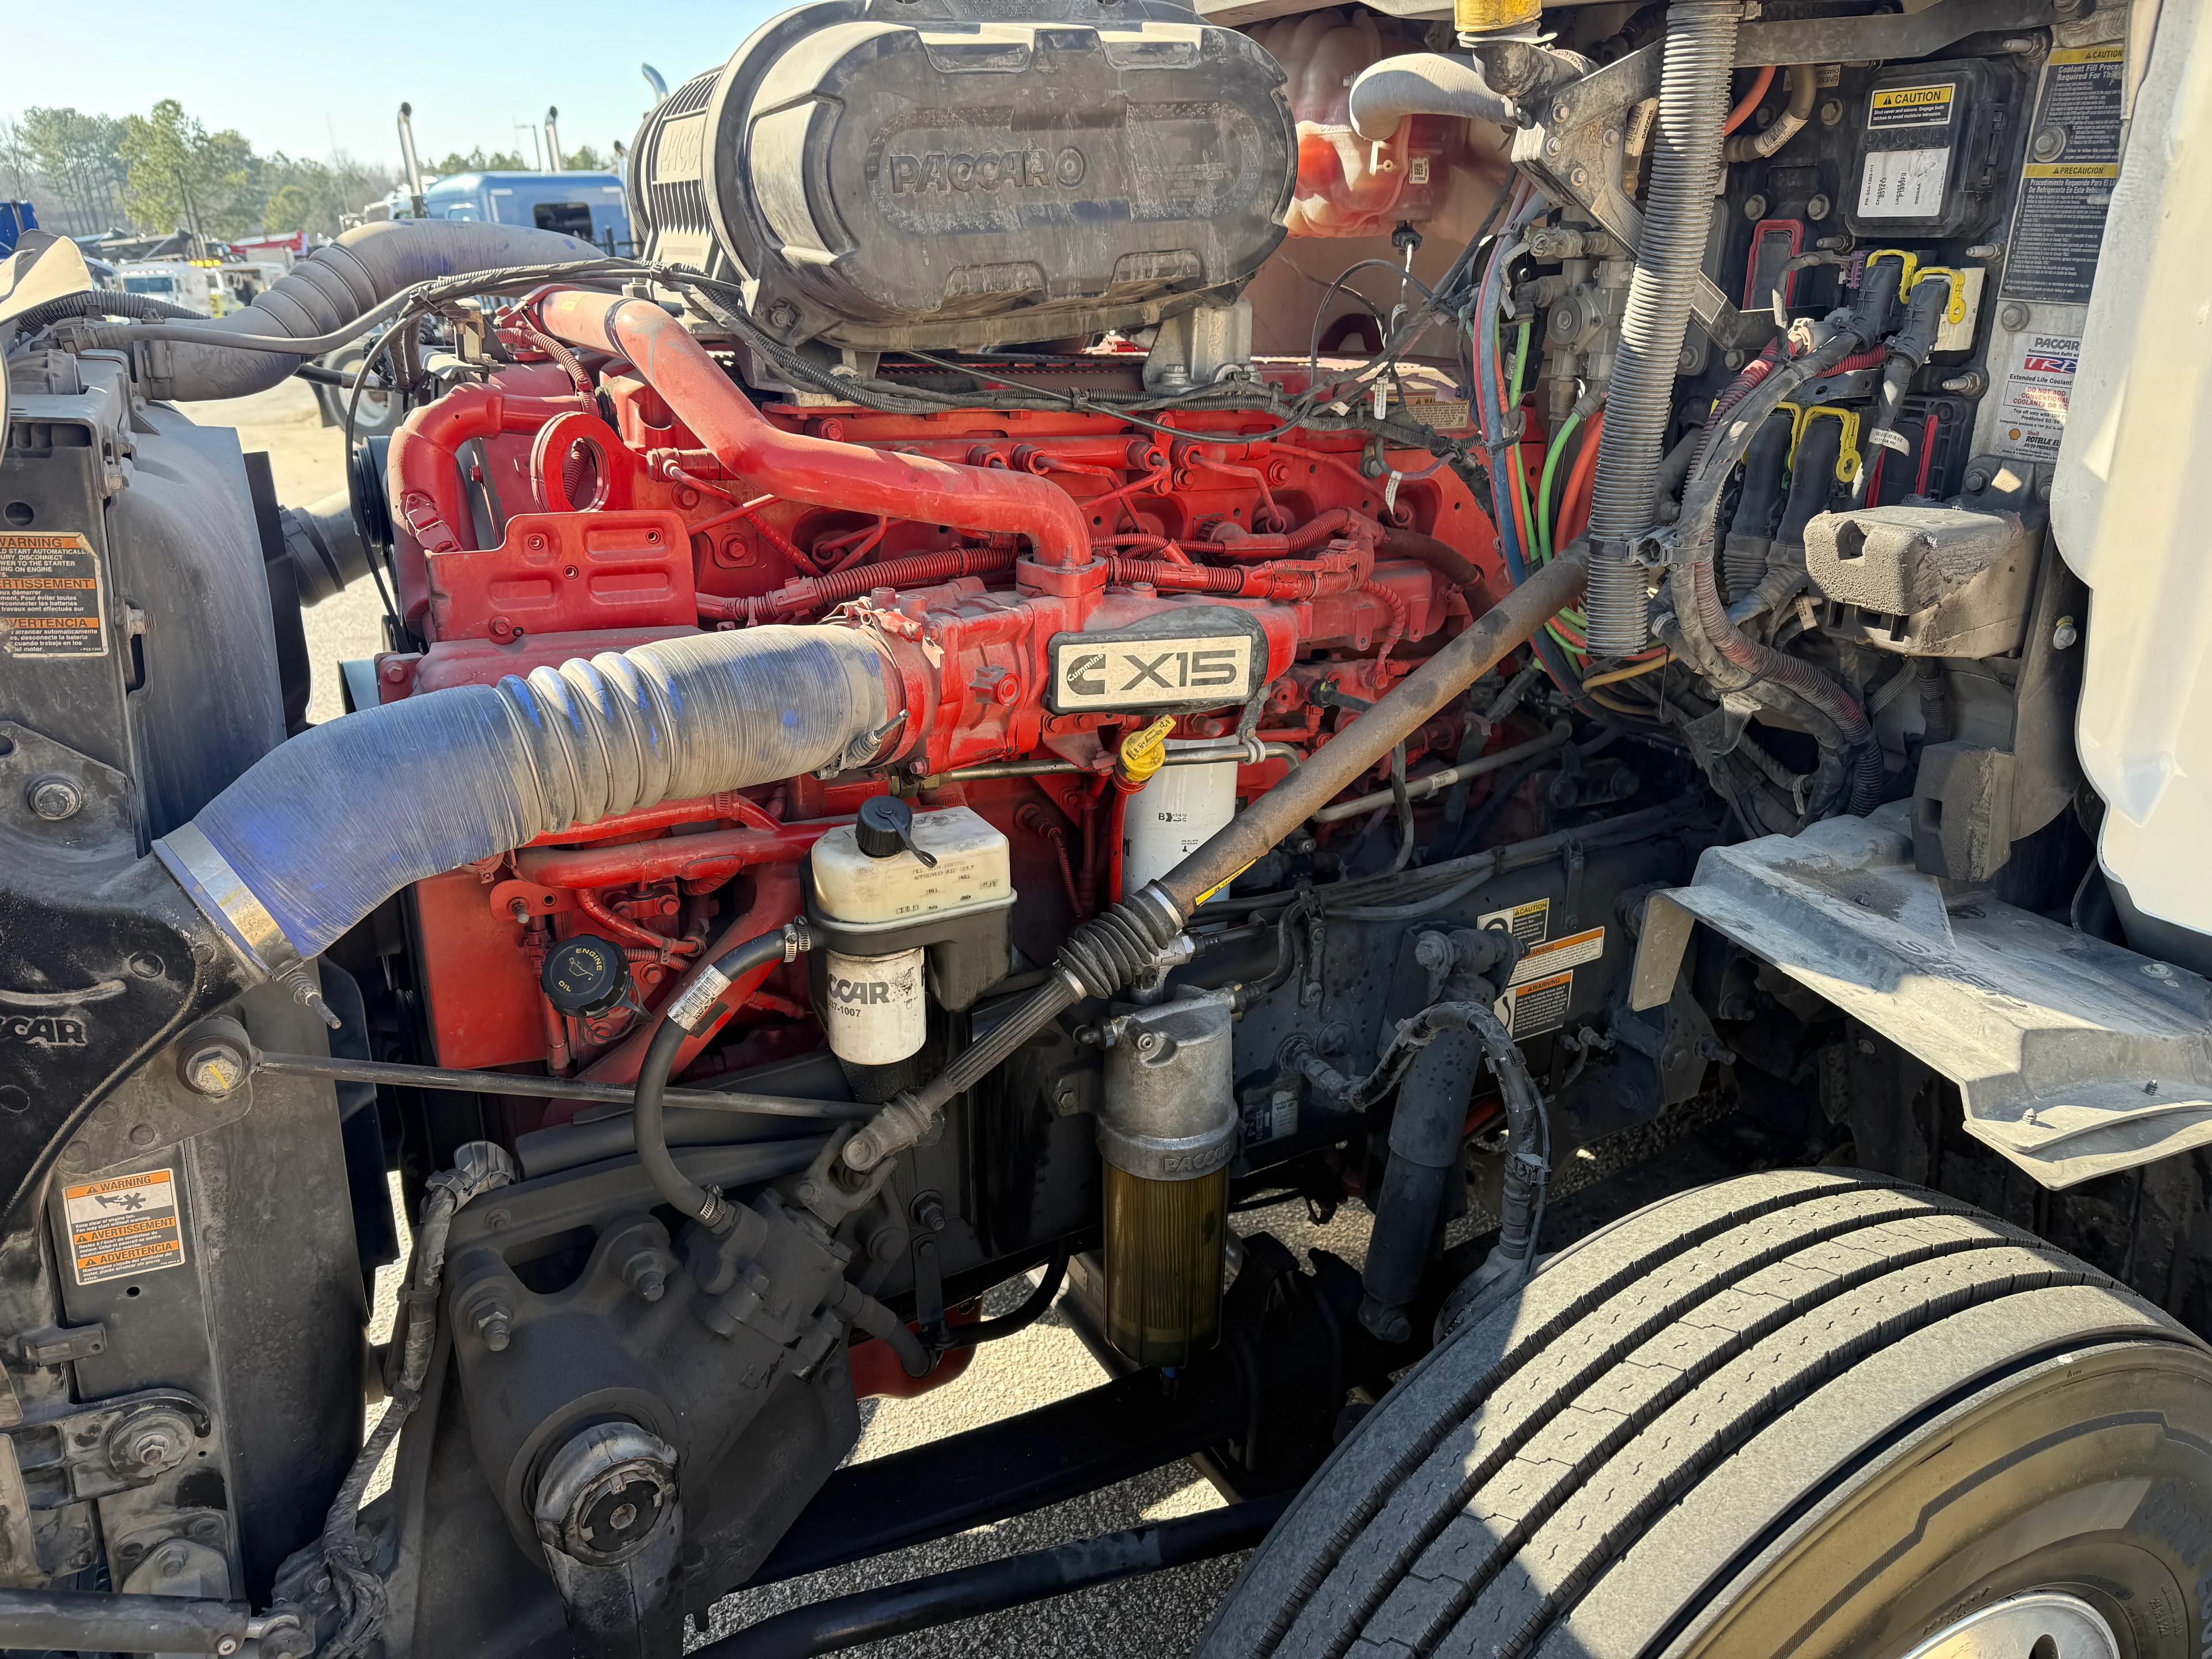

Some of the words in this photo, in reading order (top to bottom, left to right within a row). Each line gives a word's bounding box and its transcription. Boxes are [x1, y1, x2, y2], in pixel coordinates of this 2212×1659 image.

[2092, 50, 2123, 58] CAUTION
[2058, 65, 2085, 73] Coolant
[2056, 73, 2088, 81] Required
[2089, 71, 2101, 79] For
[1895, 90, 1941, 104] CAUTION
[1642, 109, 1653, 139] PACCAR
[889, 148, 1051, 193] PACCAR
[2037, 187, 2065, 195] Refrigerante
[2035, 338, 2080, 350] PACCAR
[2050, 378, 2072, 386] Coolant
[2013, 398, 2046, 407] COOLANTS
[2021, 392, 2070, 403] CONVENTIONAL
[2025, 435, 2051, 445] ROTELLA
[1067, 653, 1104, 682] Cummins
[1119, 649, 1237, 691] X15
[979, 880, 998, 889] HOT
[1222, 872, 1240, 887] CAUTION
[896, 903, 919, 915] COLD
[1520, 902, 1547, 914] CAUTION
[575, 948, 603, 971] ENGINE
[558, 980, 571, 992] OIL
[828, 974, 891, 1005] CCAR
[1532, 977, 1560, 990] WARNING
[1163, 1141, 1231, 1172] PACCAR
[100, 1175, 151, 1191] WARNING
[92, 1218, 173, 1240] AVERTISSEMENT
[80, 1249, 115, 1258] soudainement
[100, 1242, 173, 1263] ADVERTENCIA
[141, 1253, 164, 1262] ventilador
